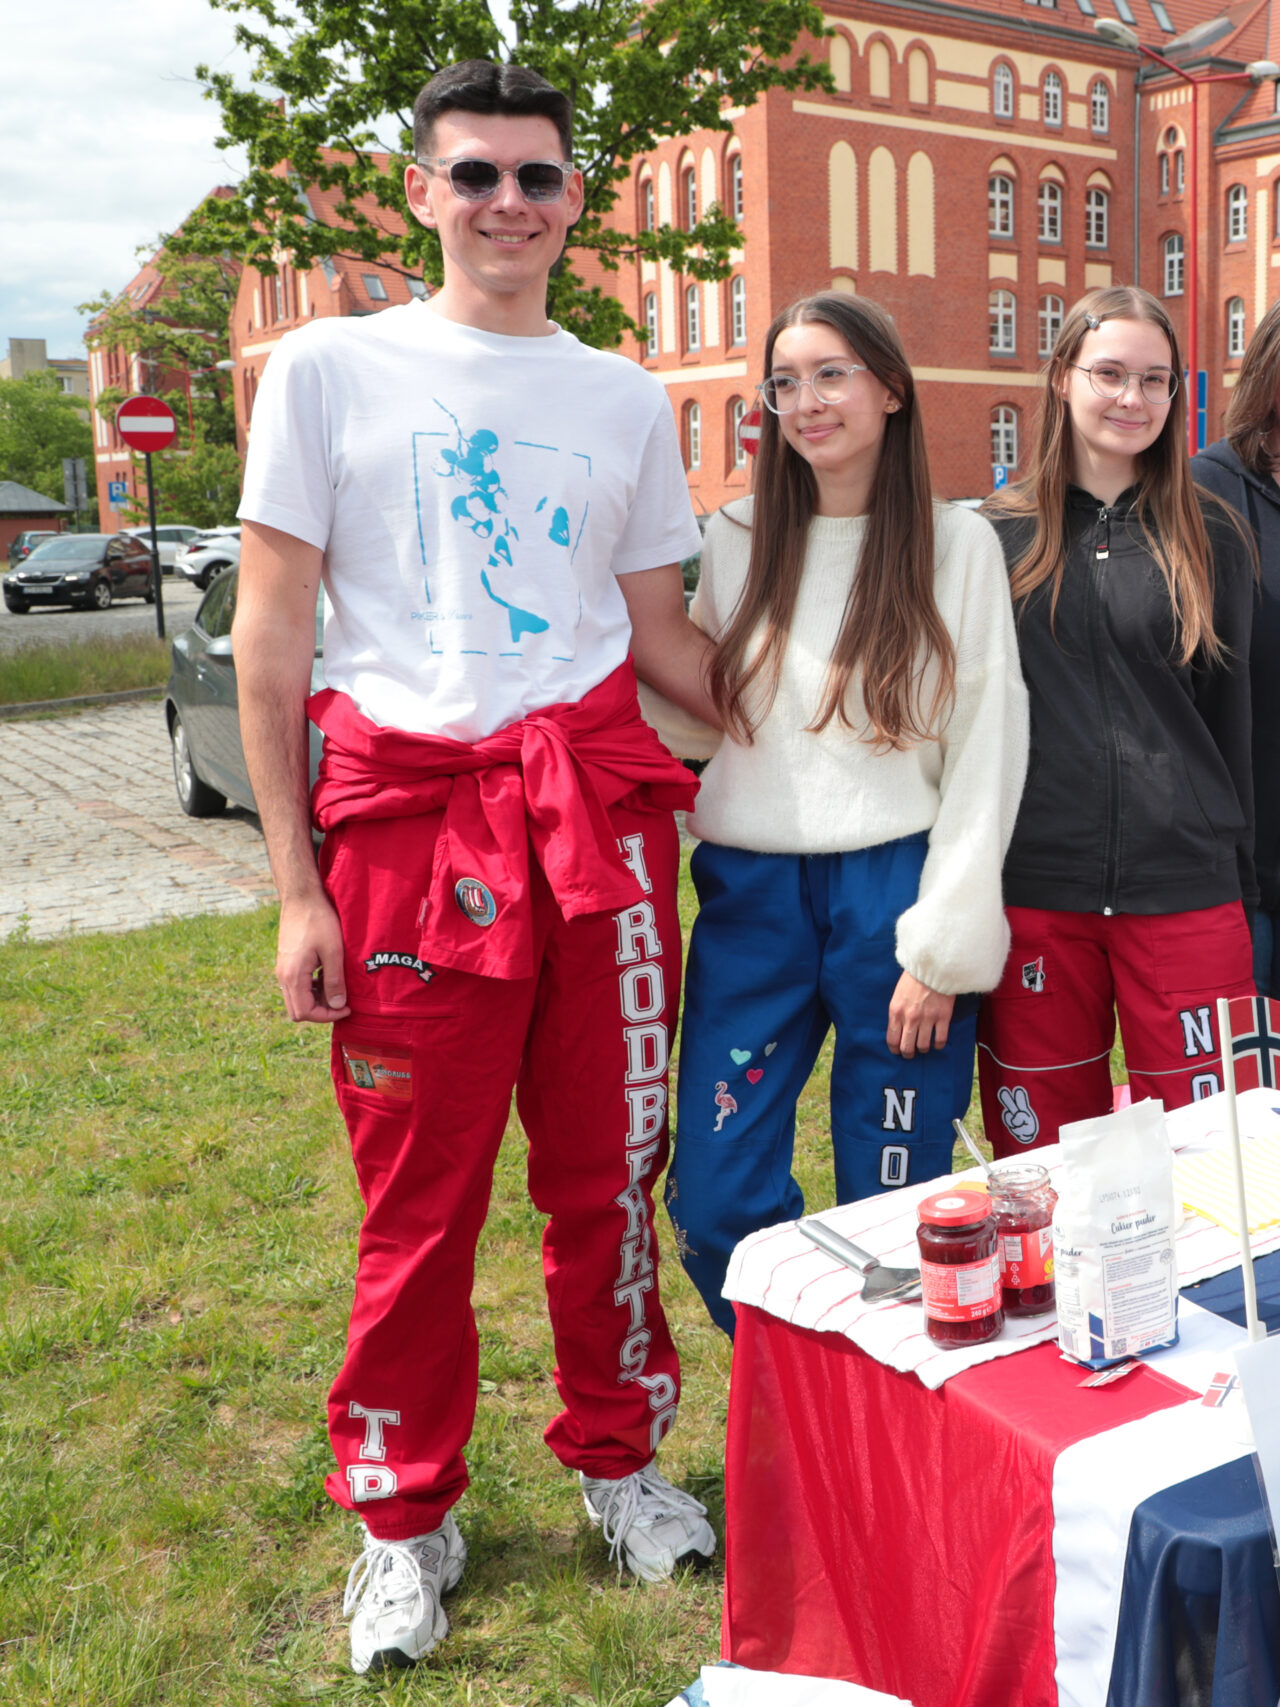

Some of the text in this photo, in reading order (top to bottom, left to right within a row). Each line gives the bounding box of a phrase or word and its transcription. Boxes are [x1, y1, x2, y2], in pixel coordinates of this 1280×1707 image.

[995, 467, 1004, 484] P
[374, 953, 424, 971] MAGA
[1110, 1221, 1133, 1235] Cukier
